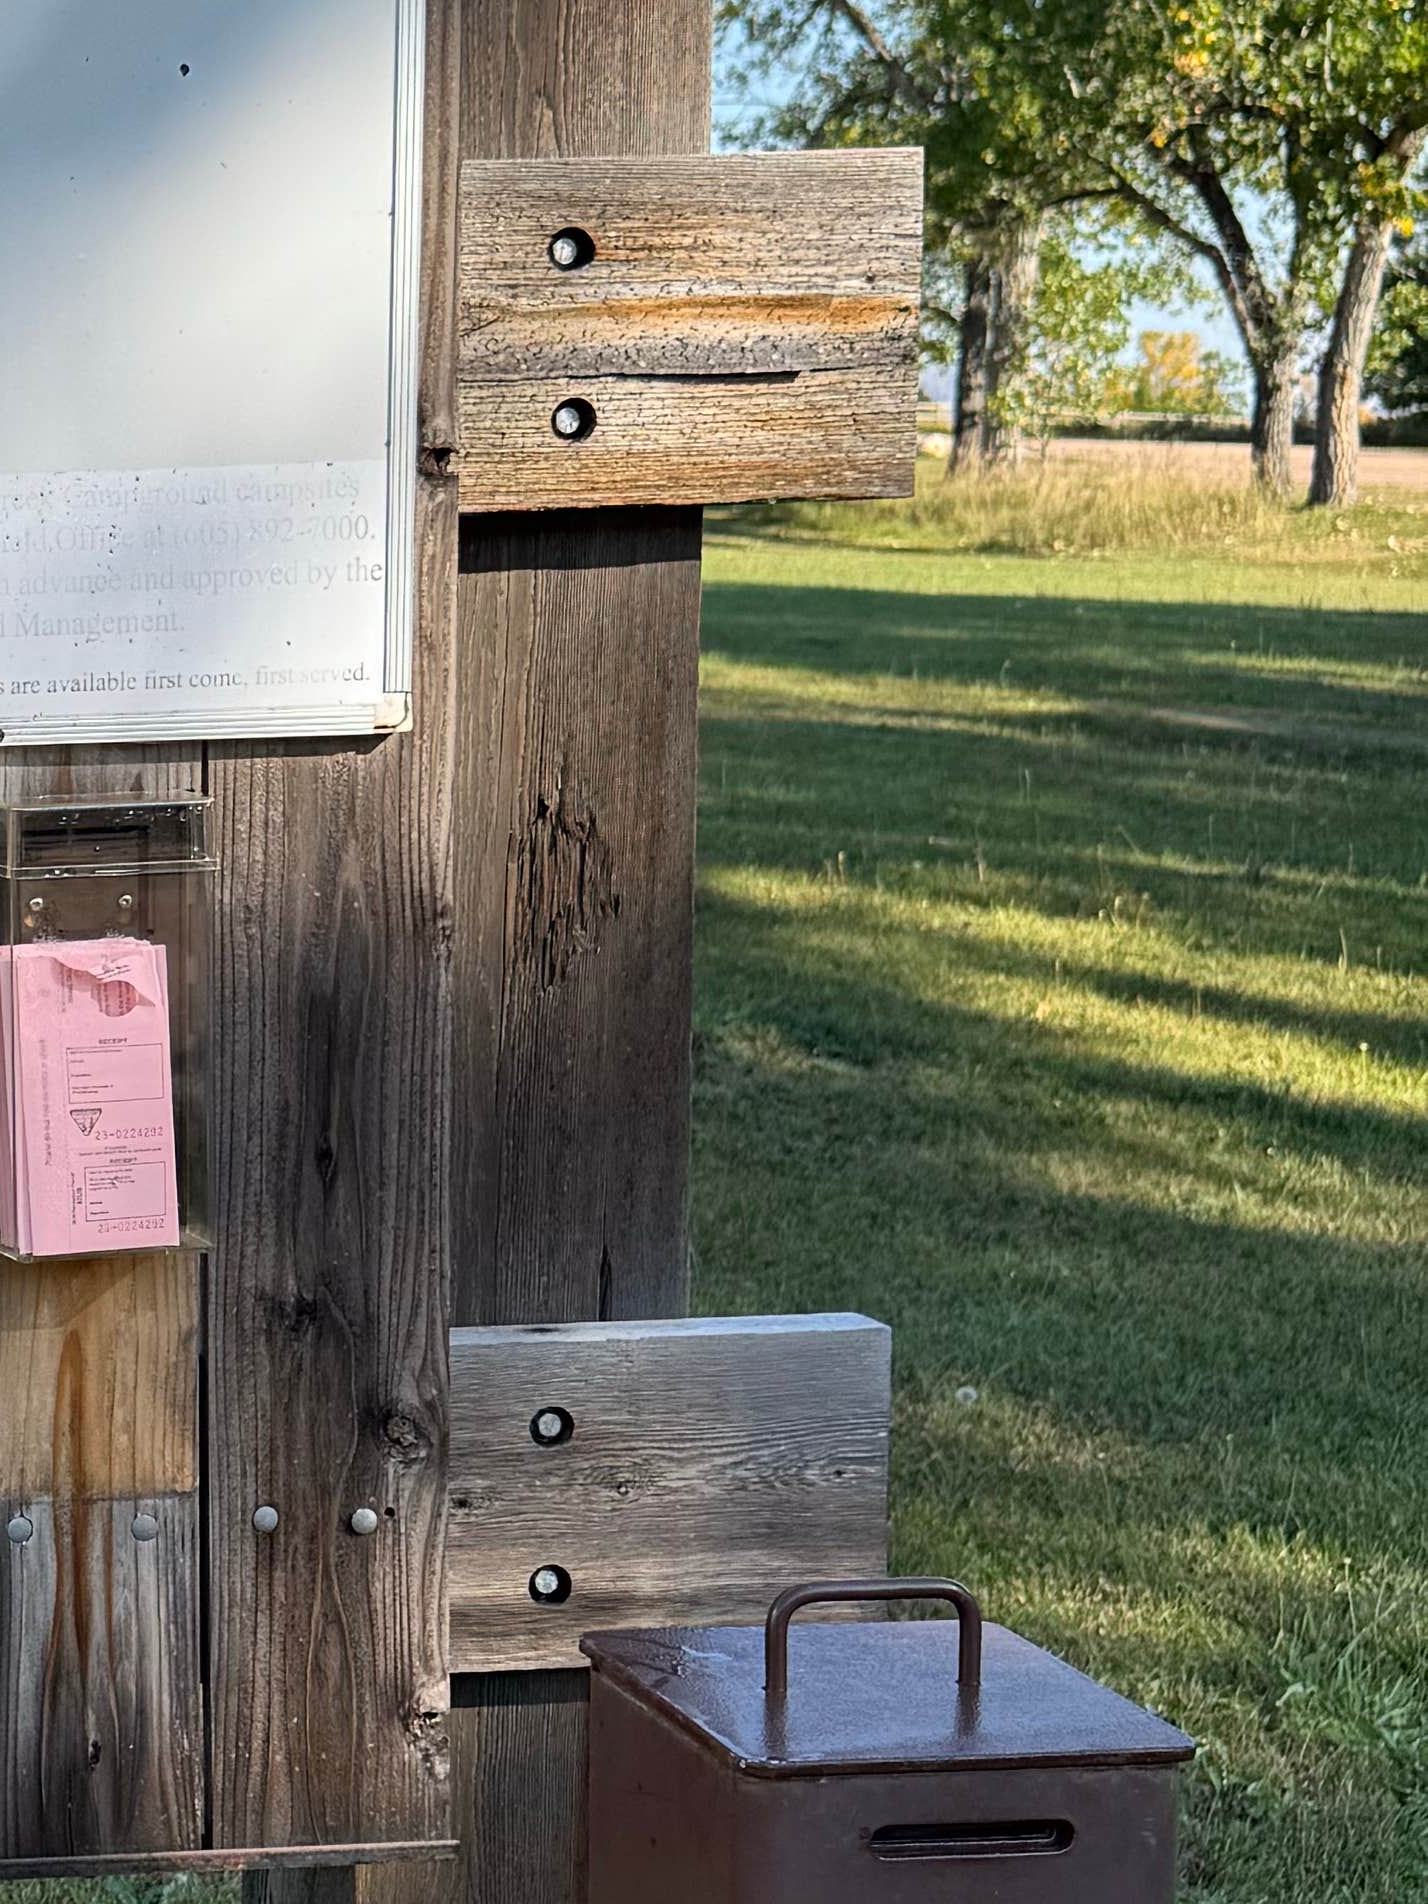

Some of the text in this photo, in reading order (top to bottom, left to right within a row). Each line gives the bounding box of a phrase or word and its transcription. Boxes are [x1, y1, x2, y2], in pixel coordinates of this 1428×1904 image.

[18, 566, 122, 595] advance
[130, 564, 174, 591] and
[183, 559, 298, 596] approved
[306, 559, 338, 590] by
[345, 556, 384, 582] the
[13, 609, 185, 641] Management.
[10, 679, 41, 696] are
[46, 671, 137, 694] available
[144, 667, 183, 689] first
[255, 664, 294, 686] first
